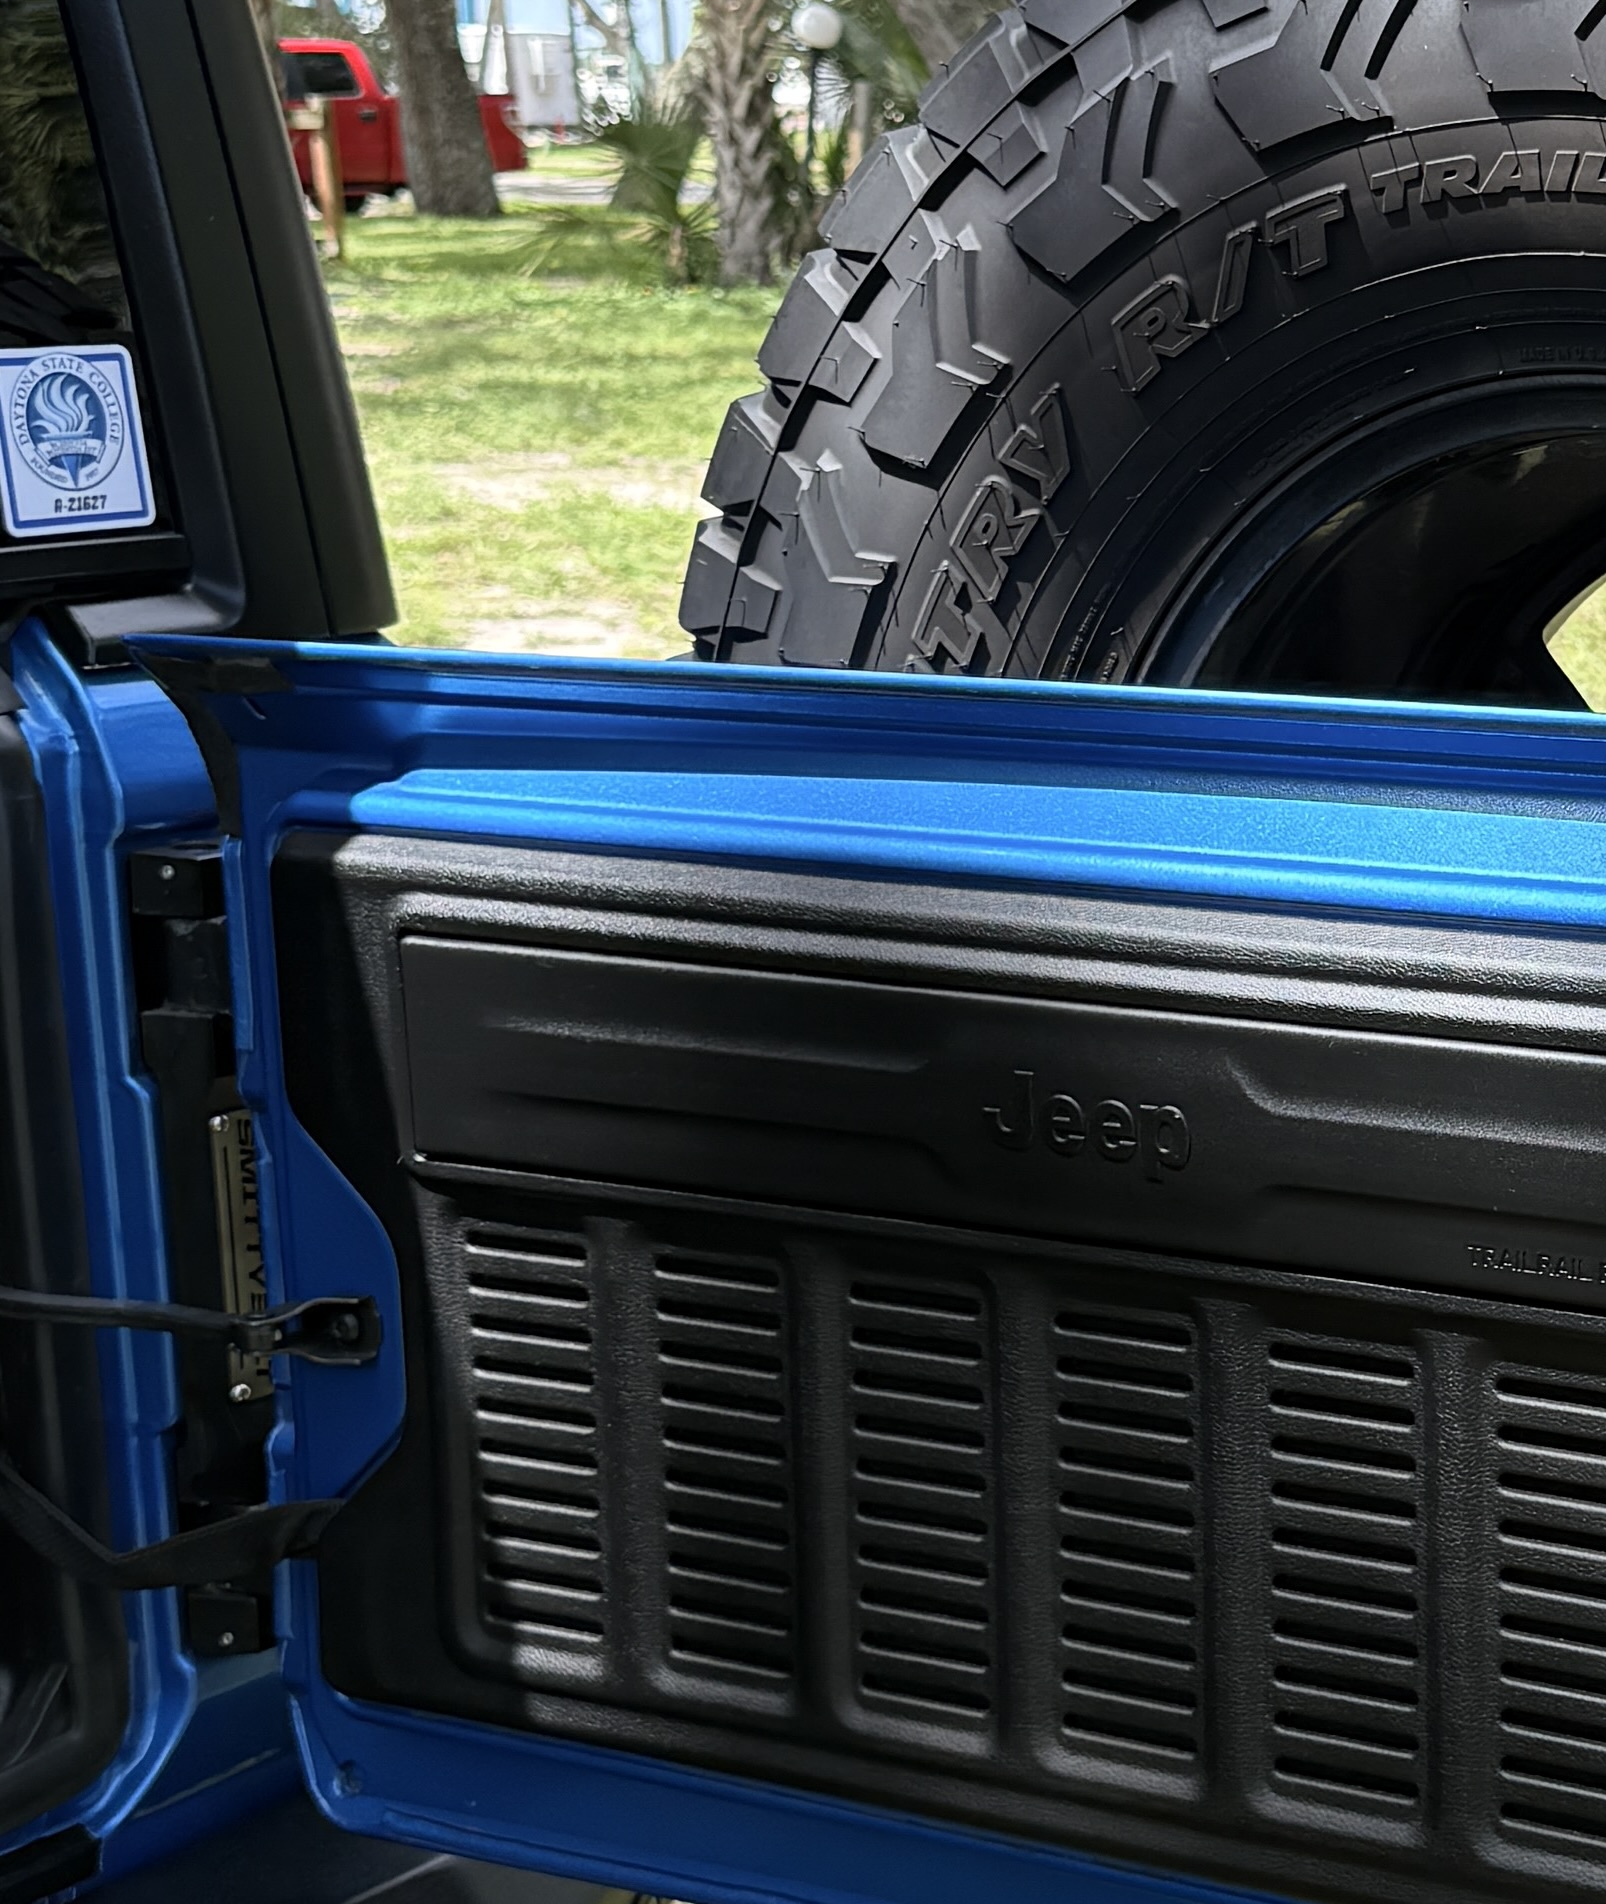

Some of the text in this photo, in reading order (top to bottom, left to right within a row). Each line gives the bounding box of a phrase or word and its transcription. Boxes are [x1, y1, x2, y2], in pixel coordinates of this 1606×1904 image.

[14, 357, 121, 446] DAYTONA STATE COLLEGE
[906, 383, 1070, 676] TRY
[1111, 183, 1348, 393] R/T
[54, 494, 108, 514] A-21627
[981, 1070, 1193, 1184] Jeep
[1466, 1245, 1594, 1283] TRAILRAIL
